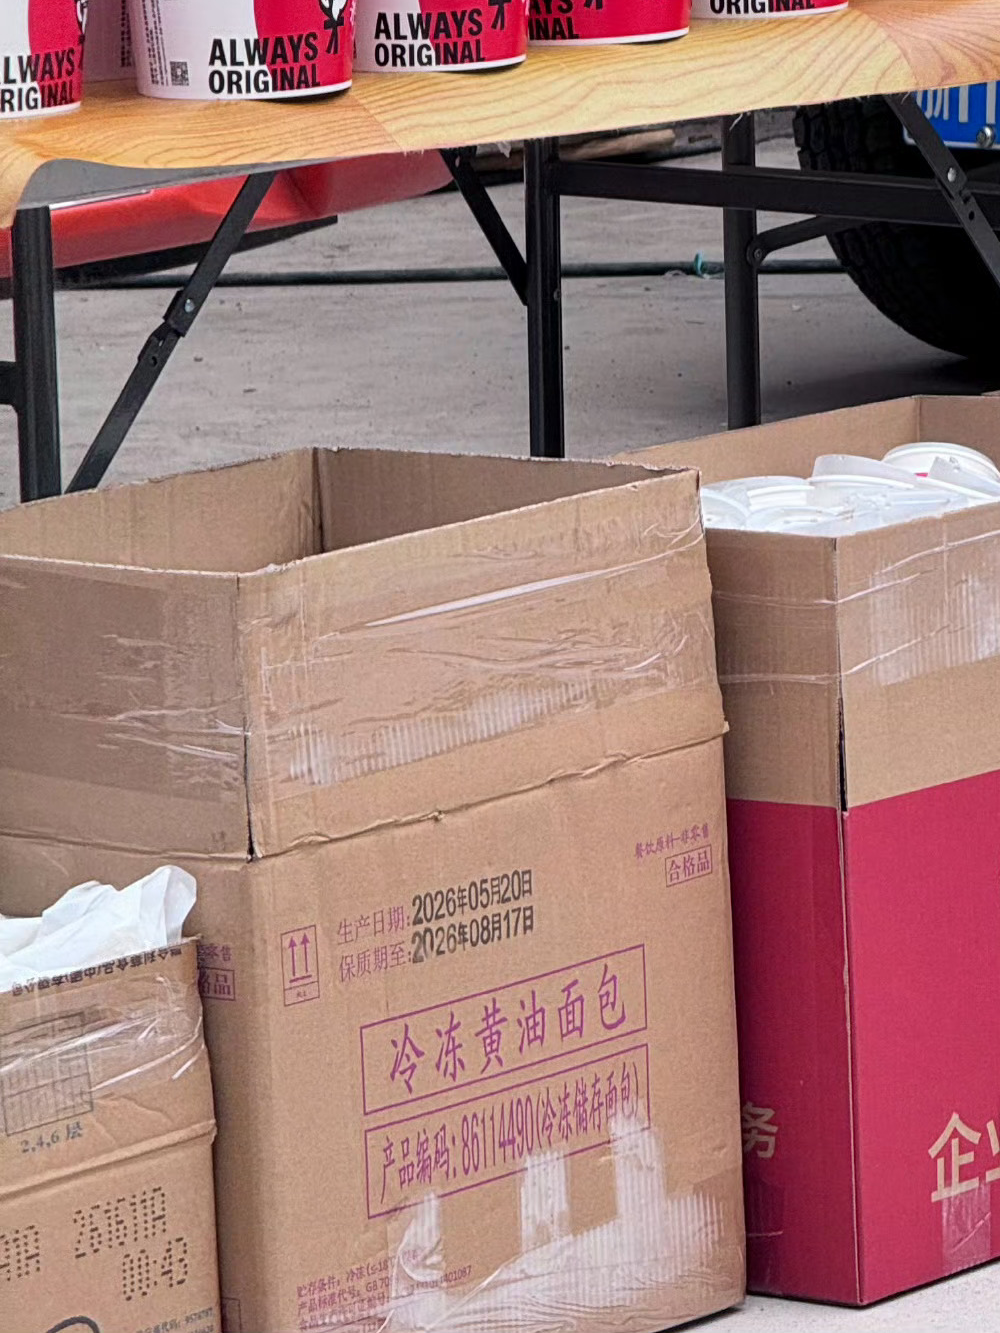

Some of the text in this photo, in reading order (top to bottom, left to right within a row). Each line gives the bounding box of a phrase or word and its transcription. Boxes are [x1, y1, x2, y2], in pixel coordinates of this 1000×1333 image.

[375, 9, 483, 40] ALWAYS
[209, 32, 318, 66] ALWAYS
[375, 40, 485, 67] ORIGINAL
[0, 48, 75, 85] LWAYS
[208, 64, 320, 94] ORIGINAL
[0, 79, 74, 113] RIGINAL
[669, 850, 710, 882] 合格品
[390, 963, 626, 1094] 冷冻黄油面包
